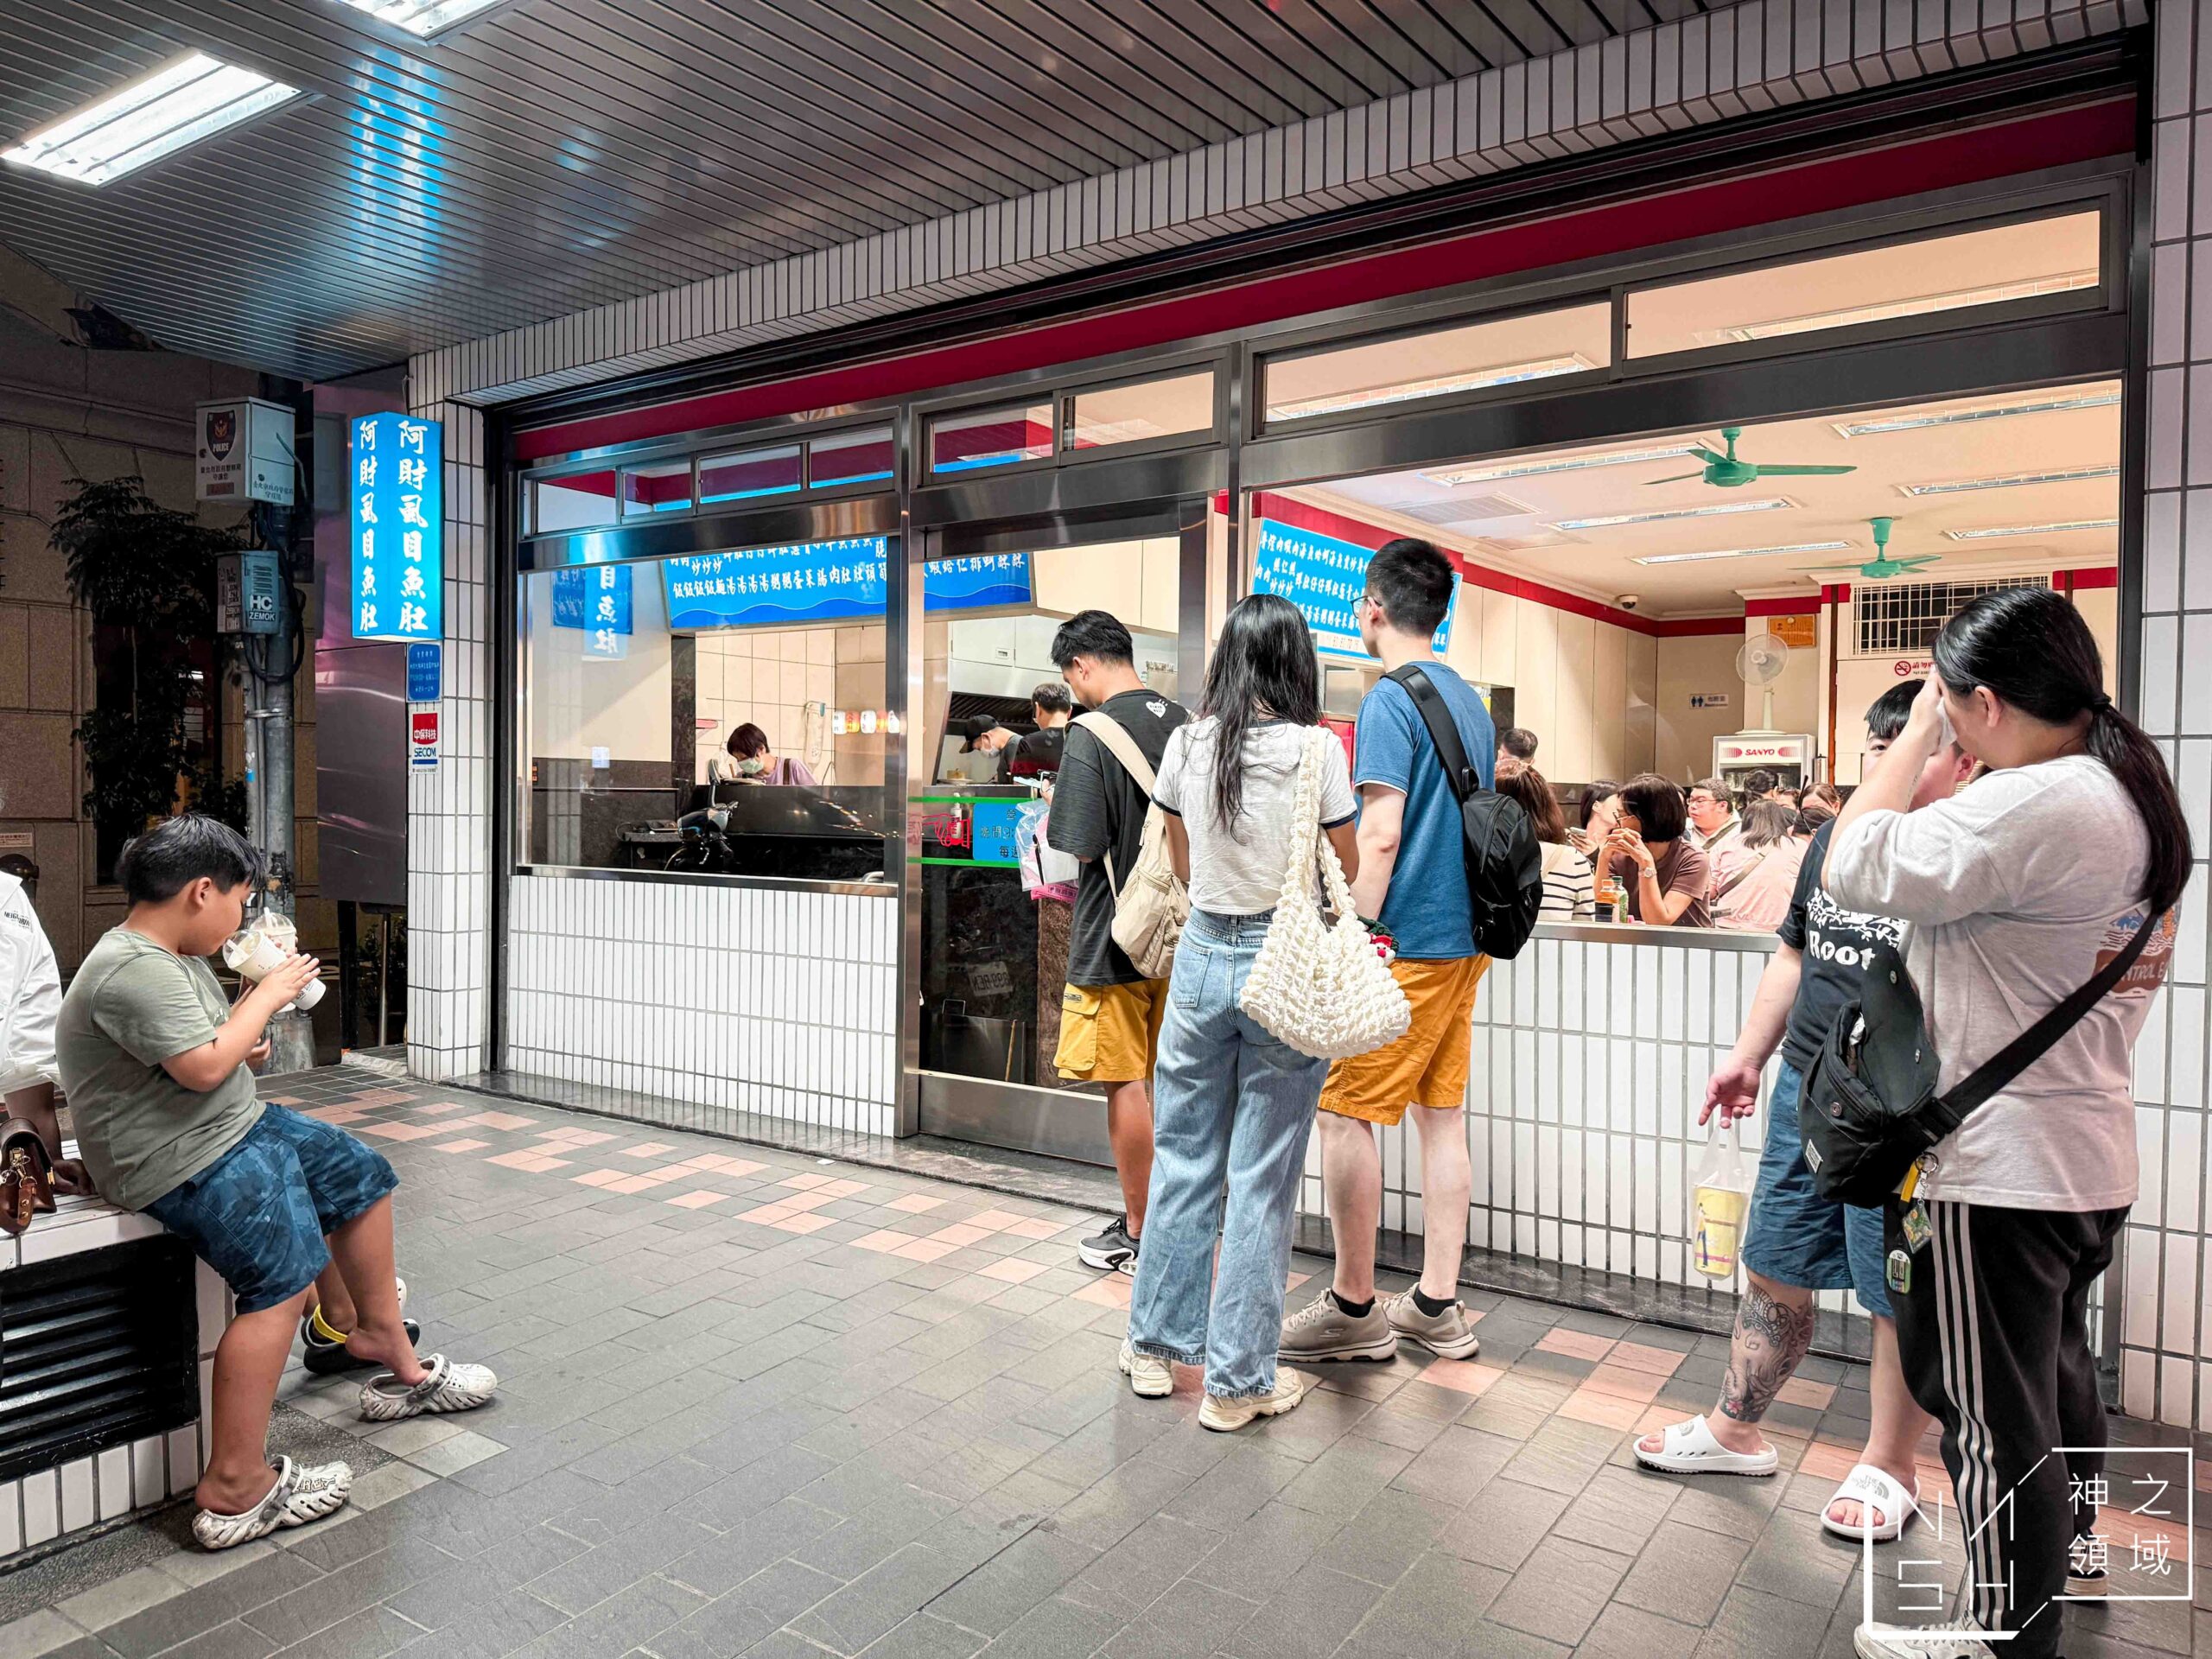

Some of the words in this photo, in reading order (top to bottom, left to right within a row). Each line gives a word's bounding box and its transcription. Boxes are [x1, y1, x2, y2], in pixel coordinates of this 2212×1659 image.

[359, 420, 378, 632] 阿財虱目魚肚
[398, 420, 429, 632] 阿財虱目魚肚
[249, 612, 276, 620] ZEMOK
[250, 594, 273, 611] HC
[414, 747, 436, 757] SECOM
[1808, 930, 1876, 970] Root
